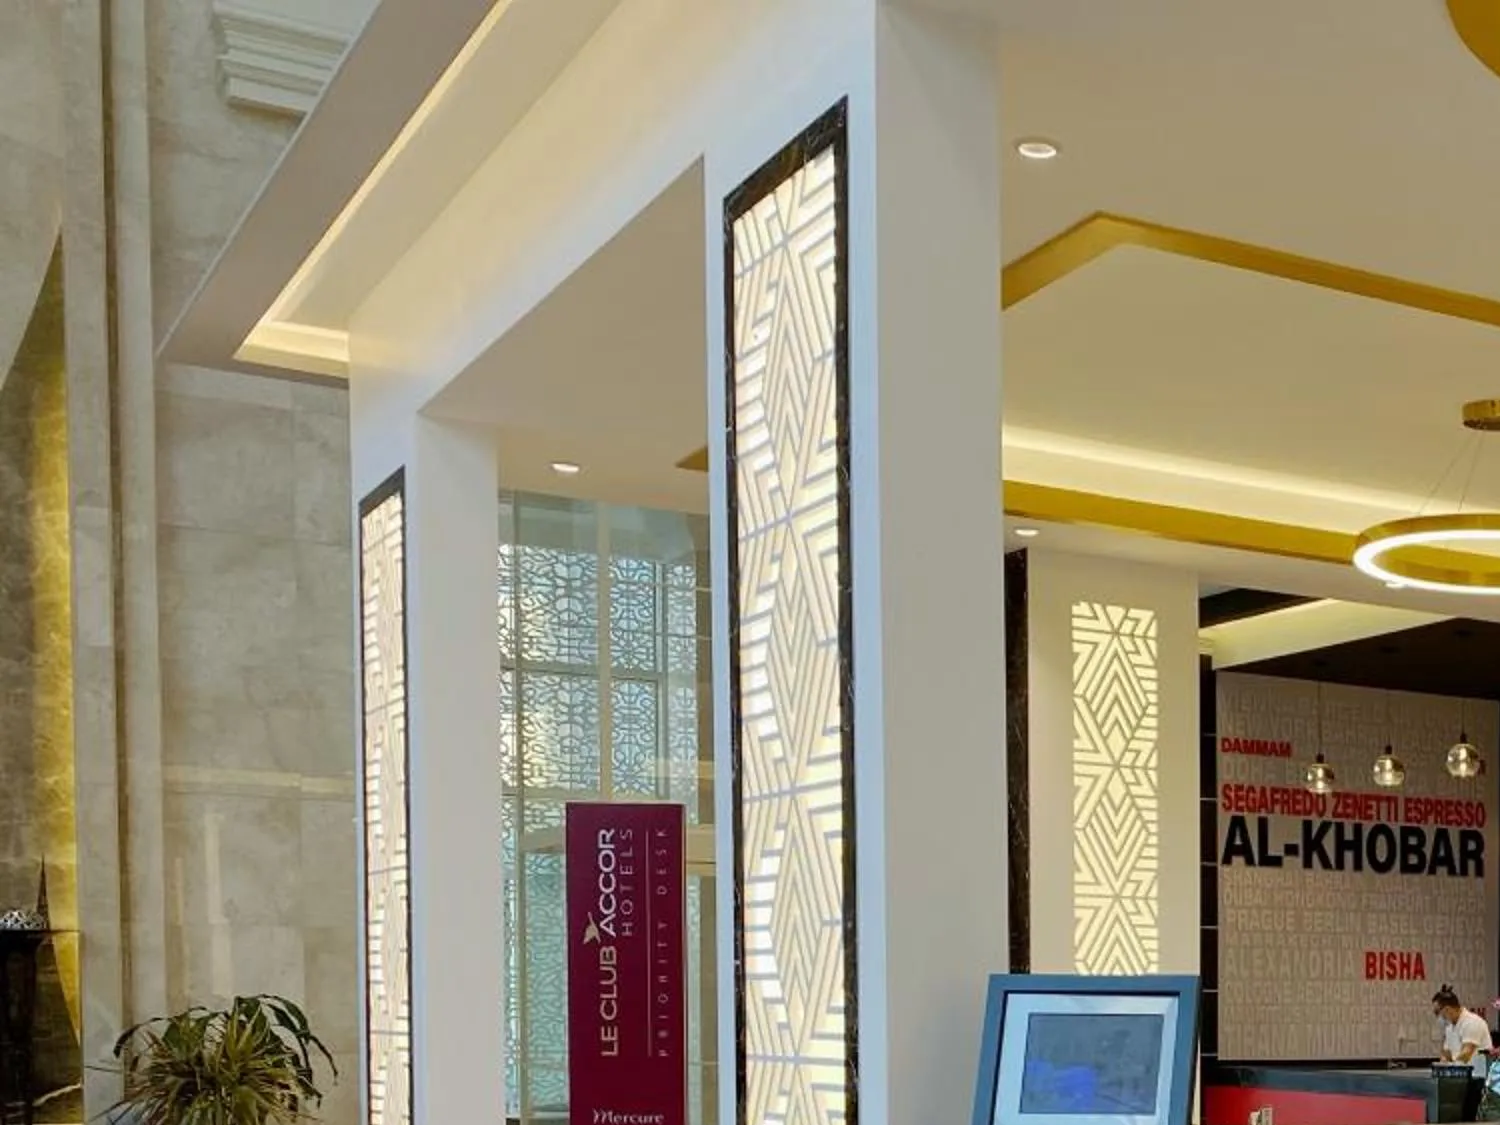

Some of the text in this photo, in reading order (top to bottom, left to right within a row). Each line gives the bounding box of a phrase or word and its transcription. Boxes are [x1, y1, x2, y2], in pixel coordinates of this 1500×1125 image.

[1221, 737, 1292, 758] DAMMAM
[1222, 783, 1486, 828] SEGAFREDO ZENETTI ESPRESSO
[1222, 815, 1485, 878] AL-KHOBAR
[620, 828, 633, 936] HOTELS
[598, 829, 618, 1056] LE CLUB ACCOR
[656, 829, 669, 1057] PRIORITY DESK
[1365, 951, 1426, 980] BISHA
[592, 1107, 664, 1125] Mercure
